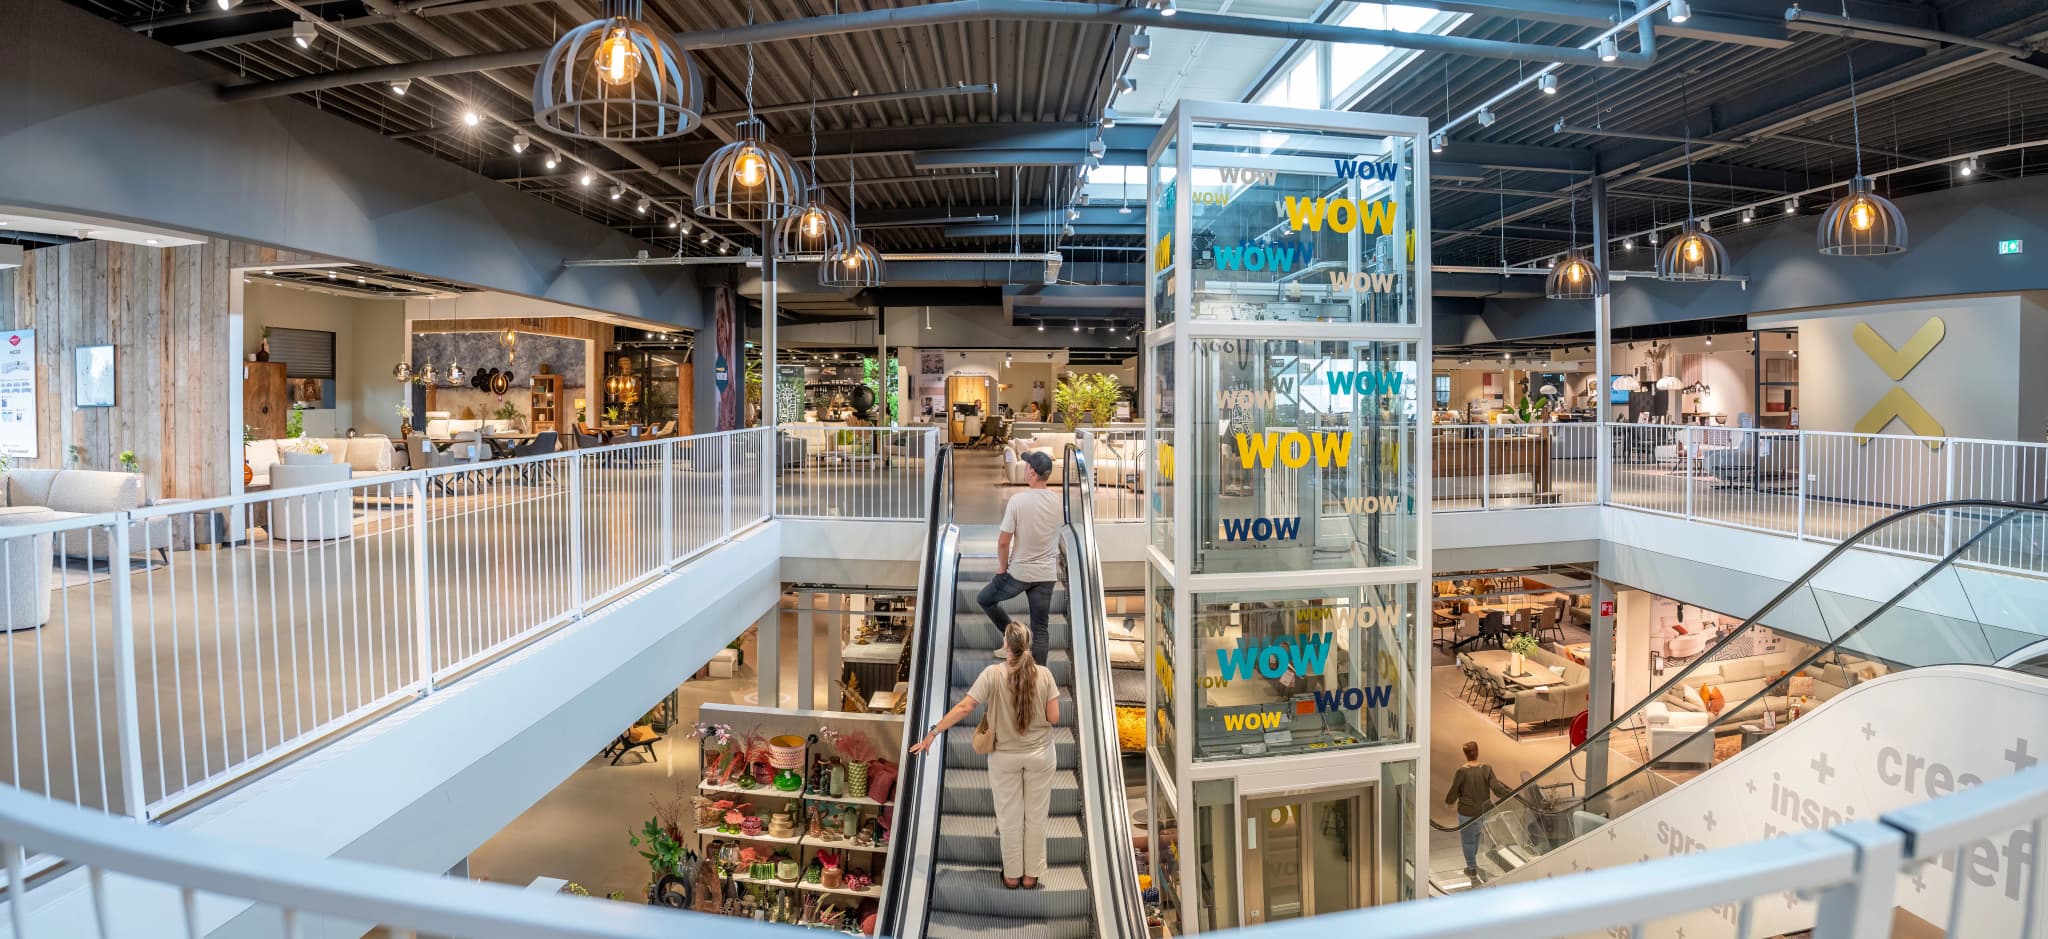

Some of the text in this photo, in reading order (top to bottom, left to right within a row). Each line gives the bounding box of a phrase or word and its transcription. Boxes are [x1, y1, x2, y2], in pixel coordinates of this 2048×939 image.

[1220, 167, 1277, 186] WOW
[1335, 159, 1398, 182] WOW
[1284, 195, 1398, 235] WOW
[1213, 244, 1295, 272] WOW
[1329, 271, 1395, 293] WOW
[1326, 371, 1403, 396] WOW
[1216, 389, 1277, 410] WOW
[1236, 432, 1353, 469] WOW
[1344, 495, 1399, 514] WOW
[1223, 516, 1301, 542] WOW
[1296, 606, 1333, 621] WOW
[1332, 603, 1401, 630] WOW
[1216, 643, 1330, 681] WOW
[1313, 684, 1393, 713] WOW
[1223, 711, 1282, 732] WOW
